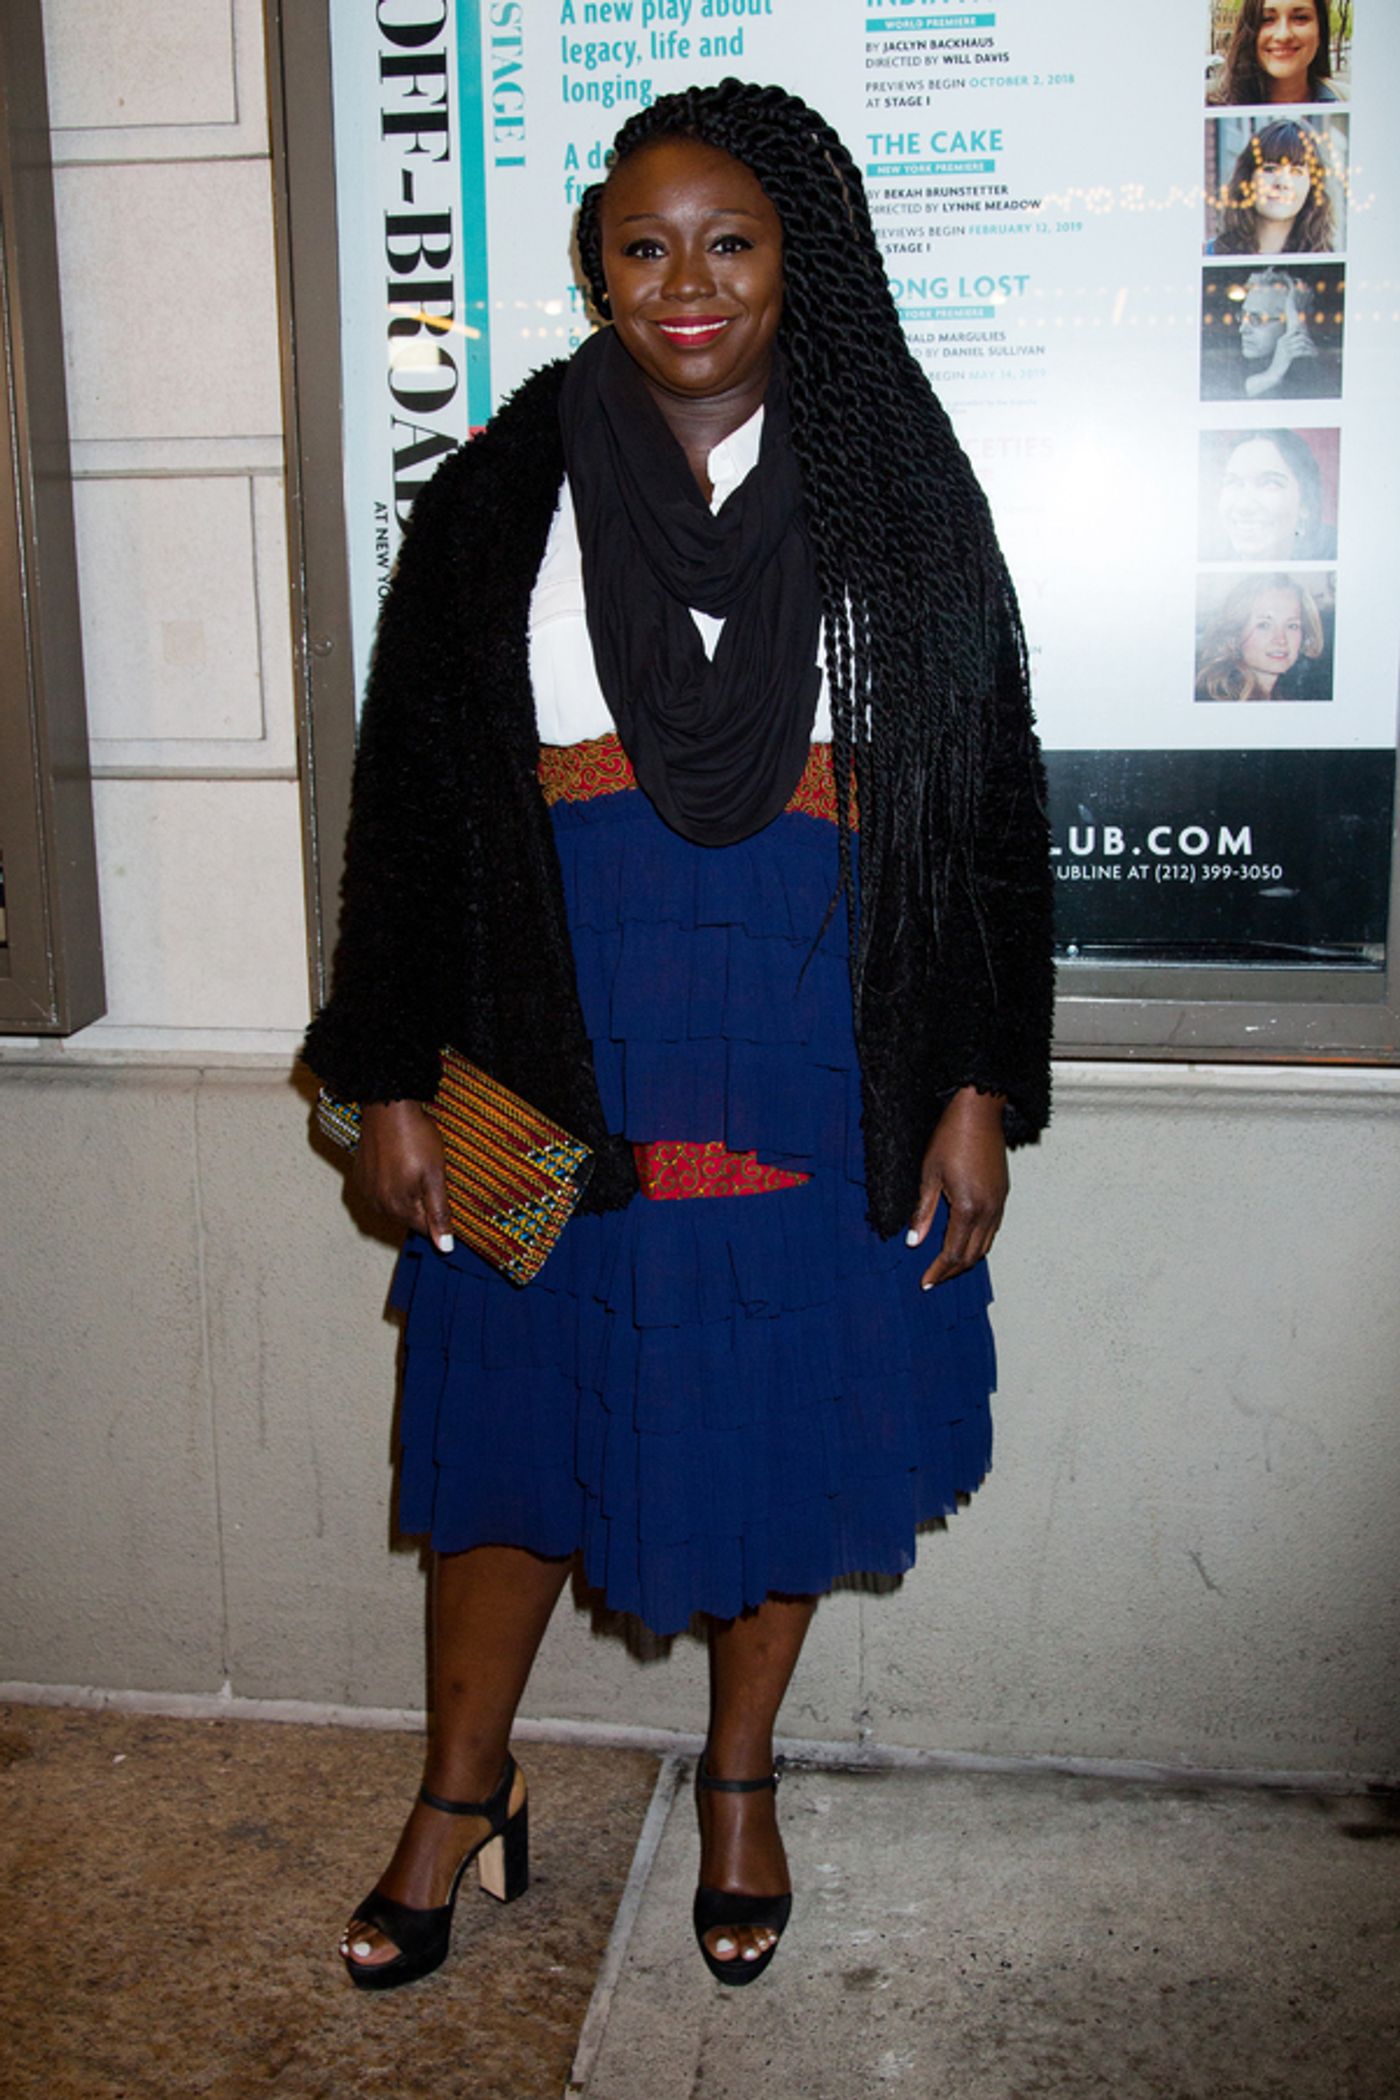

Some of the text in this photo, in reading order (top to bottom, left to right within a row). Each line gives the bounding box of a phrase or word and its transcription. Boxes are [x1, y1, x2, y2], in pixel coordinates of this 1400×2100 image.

[560, 0, 773, 29] A new play about
[884, 16, 977, 30] WORLD PREMIERE
[561, 26, 744, 71] legacy, life and
[866, 37, 995, 53] BY JACLYN BACKHAUS
[865, 51, 1010, 69] DIRECTED BY WILL DAVIS
[489, 2, 526, 167] STAGE I
[866, 79, 925, 93] PREVIEWS
[928, 78, 966, 91] BEGIN
[968, 74, 1028, 88] OCTOBER
[1047, 73, 1075, 85] 2018
[866, 98, 880, 109] AT
[884, 96, 923, 108] STAGE
[866, 128, 1004, 156] THE CAKE
[564, 142, 579, 170] A
[876, 160, 985, 175] NEW YORK PREMIERE
[884, 186, 923, 199] BEKAH
[926, 184, 1009, 198] BRUNSTETTER
[925, 202, 939, 213] BY
[942, 200, 982, 213] LYNNE
[984, 199, 1042, 211] MEADOW
[928, 225, 966, 237] BEGIN
[968, 223, 1032, 236] FEBRUARY
[1055, 221, 1083, 233] 2019
[885, 242, 923, 254] STAGE
[888, 273, 1031, 301] ONG LOST
[904, 307, 985, 320] YORK PREMIERE
[904, 330, 1007, 344] NALD MARGULIES
[925, 347, 939, 358] BY
[942, 346, 985, 358] DANIEL
[988, 345, 1046, 357] SULLIVAN
[374, 501, 388, 523] AT
[376, 527, 389, 568] NEW
[1056, 863, 1284, 884] UBLINE AT (212) 399-3050
